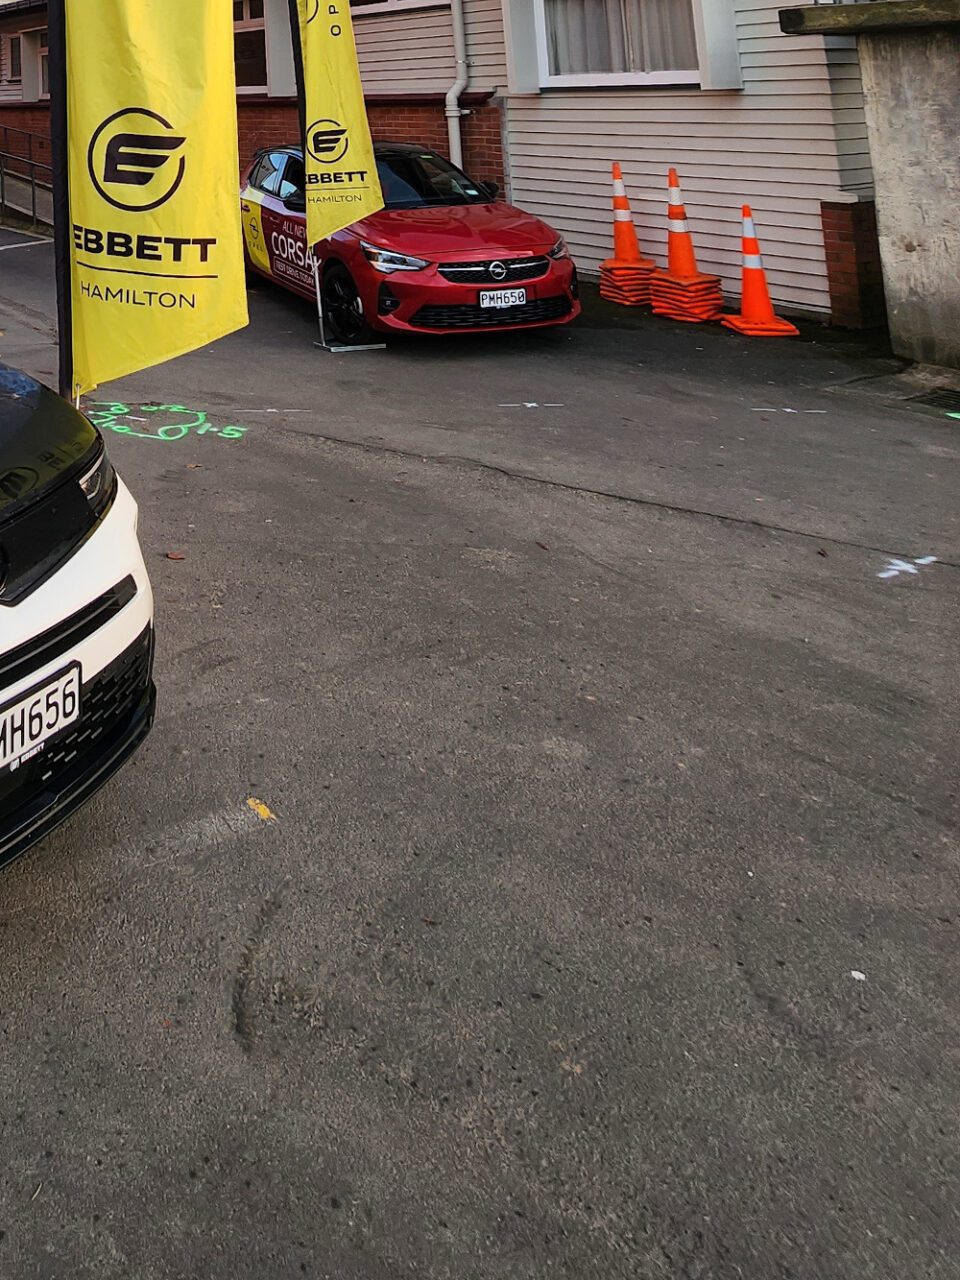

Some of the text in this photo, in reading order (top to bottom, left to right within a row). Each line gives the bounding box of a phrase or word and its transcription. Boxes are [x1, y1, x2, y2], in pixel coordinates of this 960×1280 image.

[305, 170, 368, 185] BBETT
[307, 194, 362, 204] HAMILTON
[282, 220, 294, 235] ALL
[80, 281, 196, 309] HAMILTON
[481, 290, 525, 306] PMH650
